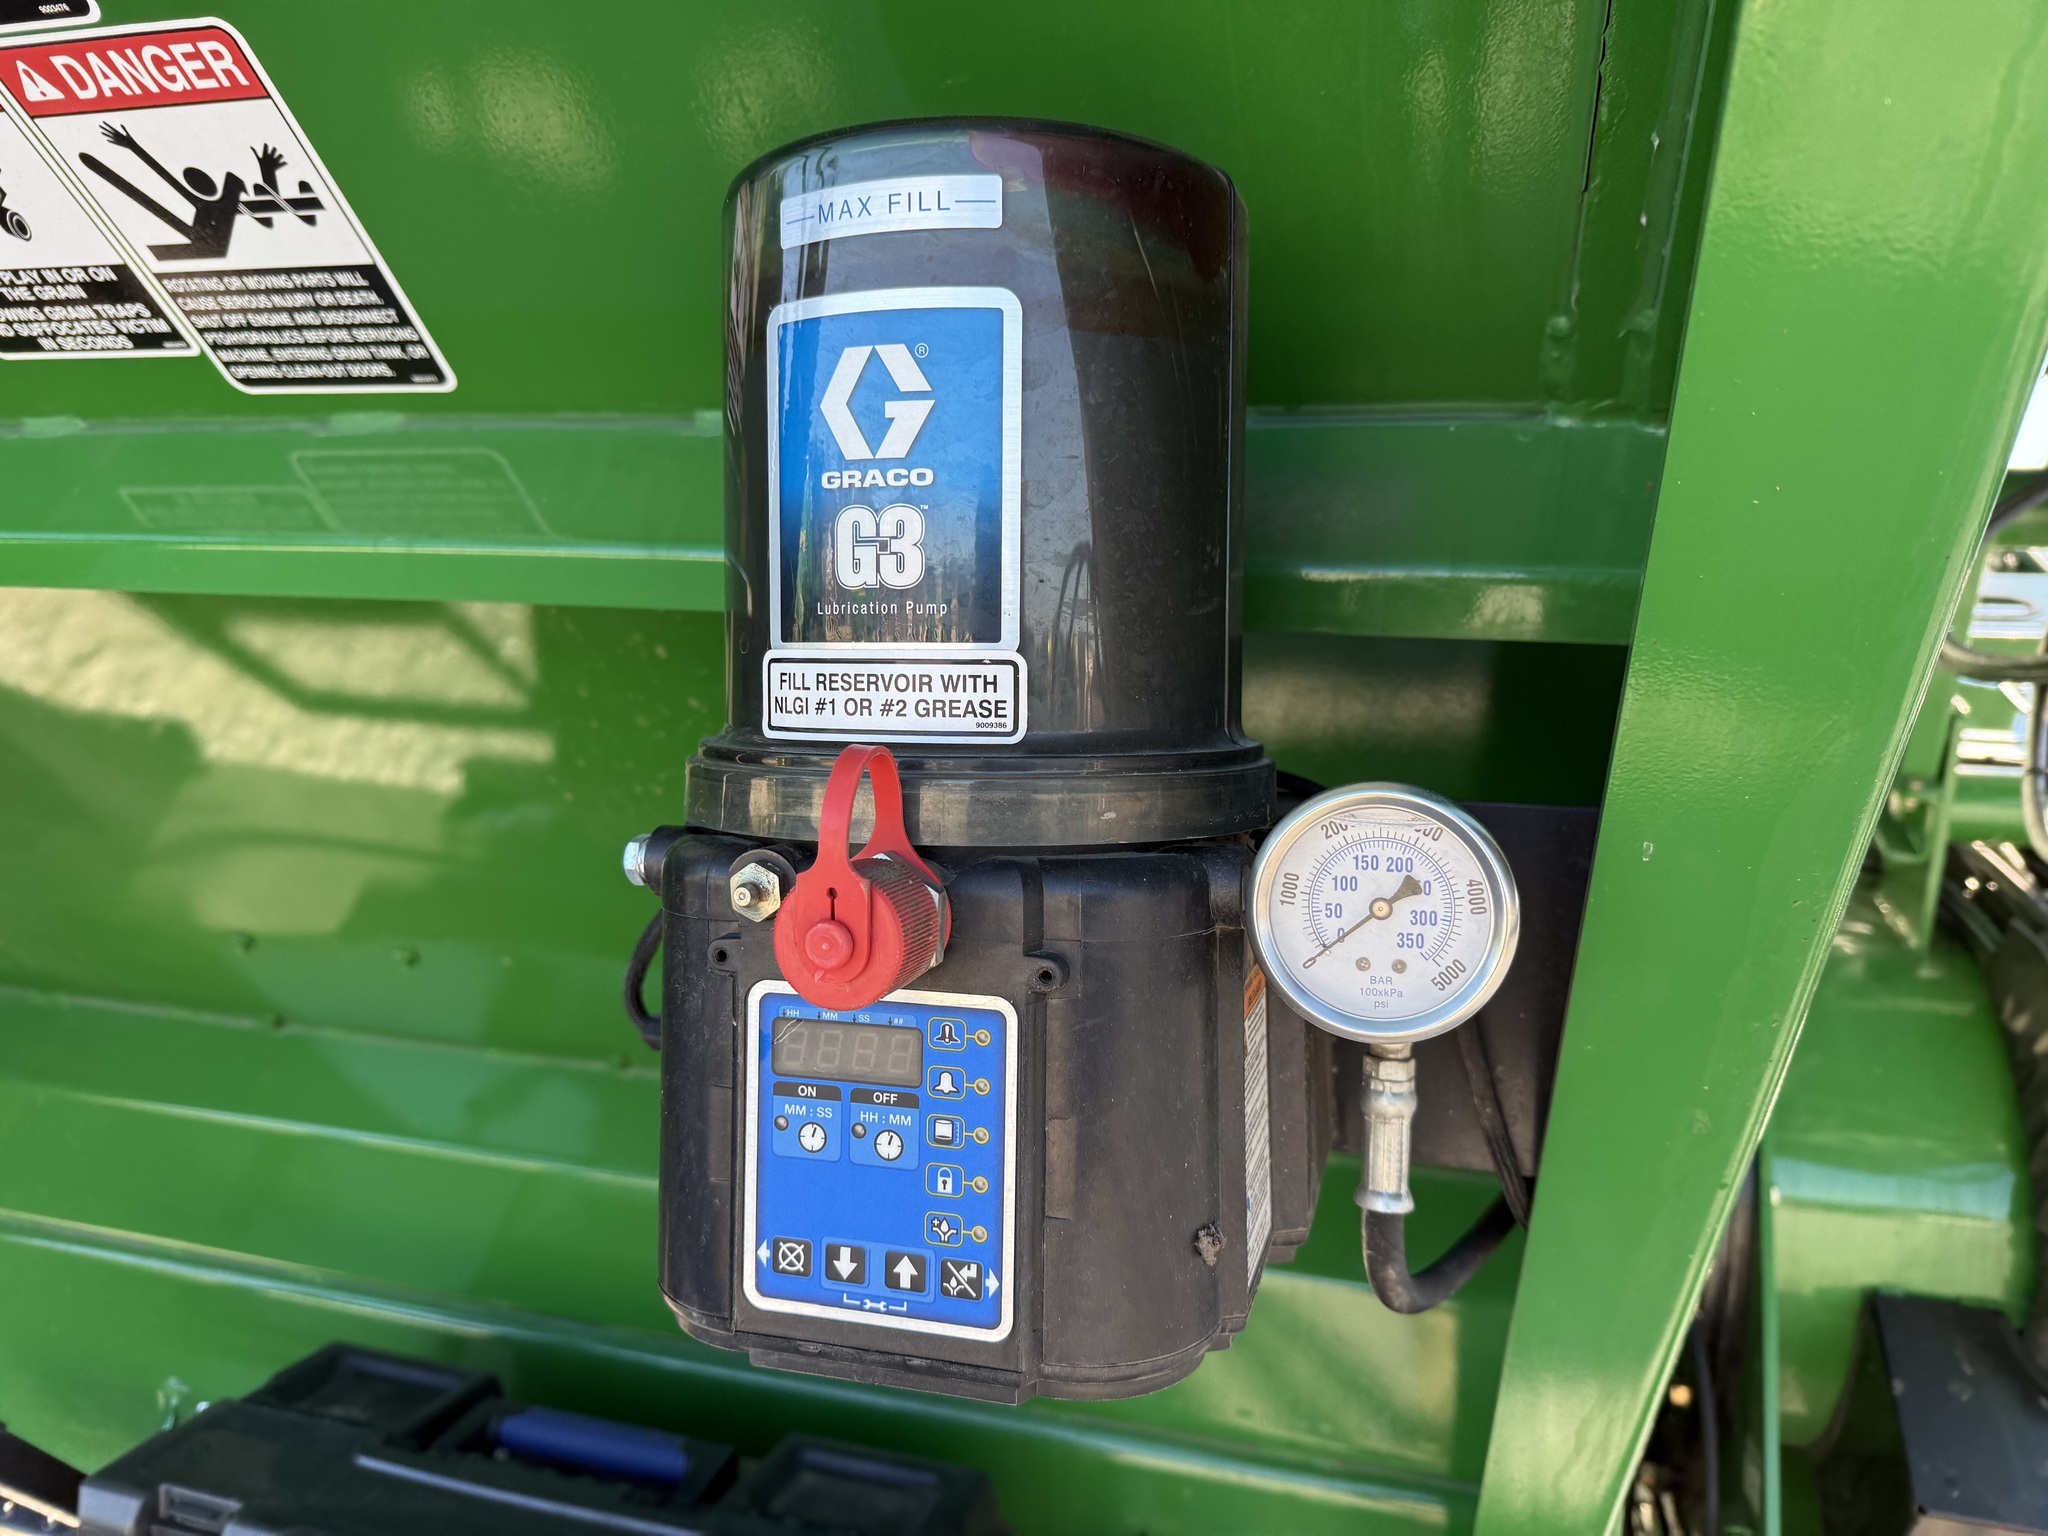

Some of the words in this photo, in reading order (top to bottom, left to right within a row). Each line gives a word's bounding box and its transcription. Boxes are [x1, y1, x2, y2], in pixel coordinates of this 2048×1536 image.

[50, 40, 251, 101] DANGER
[818, 195, 872, 225] MAX
[888, 190, 951, 214] FILL
[0, 268, 43, 286] PLAY
[40, 267, 64, 284] IN
[60, 266, 91, 283] OR
[87, 265, 119, 282] ON
[161, 276, 226, 293] ROTATING
[221, 275, 247, 290] OR
[241, 274, 295, 290] MOVING
[289, 271, 337, 288] PARTS
[332, 270, 370, 287] WILL
[0, 285, 38, 301] THE
[32, 284, 89, 300] GRAIN
[176, 295, 221, 311] CAUSE
[216, 293, 273, 310] SERIOUS
[42, 304, 98, 321] GRAIN
[91, 302, 152, 319] TRAPS
[12, 320, 118, 338] SUFFOCATES
[112, 318, 173, 334] VICTIM
[36, 336, 60, 351] IN
[54, 335, 135, 350] SECONDS
[821, 468, 934, 489] GRACO
[817, 601, 898, 616] Lubrication
[906, 601, 948, 618] Pump
[779, 672, 811, 691] FILL
[815, 672, 933, 693] RESERVOIR
[939, 674, 998, 693] WITH
[774, 695, 809, 716] NLGI
[815, 698, 837, 716] #1
[843, 698, 873, 717] OR
[880, 698, 908, 718] #2
[914, 699, 1008, 719] GREASE
[975, 721, 1008, 729] 9009386
[1353, 854, 1379, 871] 150
[1385, 857, 1414, 873] 200
[1279, 872, 1300, 907] 1000
[1331, 875, 1358, 892] 100
[1466, 878, 1488, 915] 4000
[1324, 903, 1343, 919] 50
[1409, 909, 1438, 927] 300
[1396, 932, 1425, 949] 350
[1302, 957, 1317, 970] 0
[1369, 976, 1393, 985] BAR
[1430, 958, 1467, 992] 5000
[1360, 987, 1403, 998] 100xkPa
[1374, 999, 1389, 1009] psi
[786, 1009, 800, 1017] HH
[822, 1011, 838, 1020] MM
[858, 1014, 870, 1023] SS
[798, 1085, 817, 1097] ON
[873, 1092, 898, 1104] OFF
[784, 1104, 806, 1116] MM
[816, 1107, 833, 1119] SS
[860, 1111, 879, 1123] HH
[889, 1114, 912, 1126] MM
